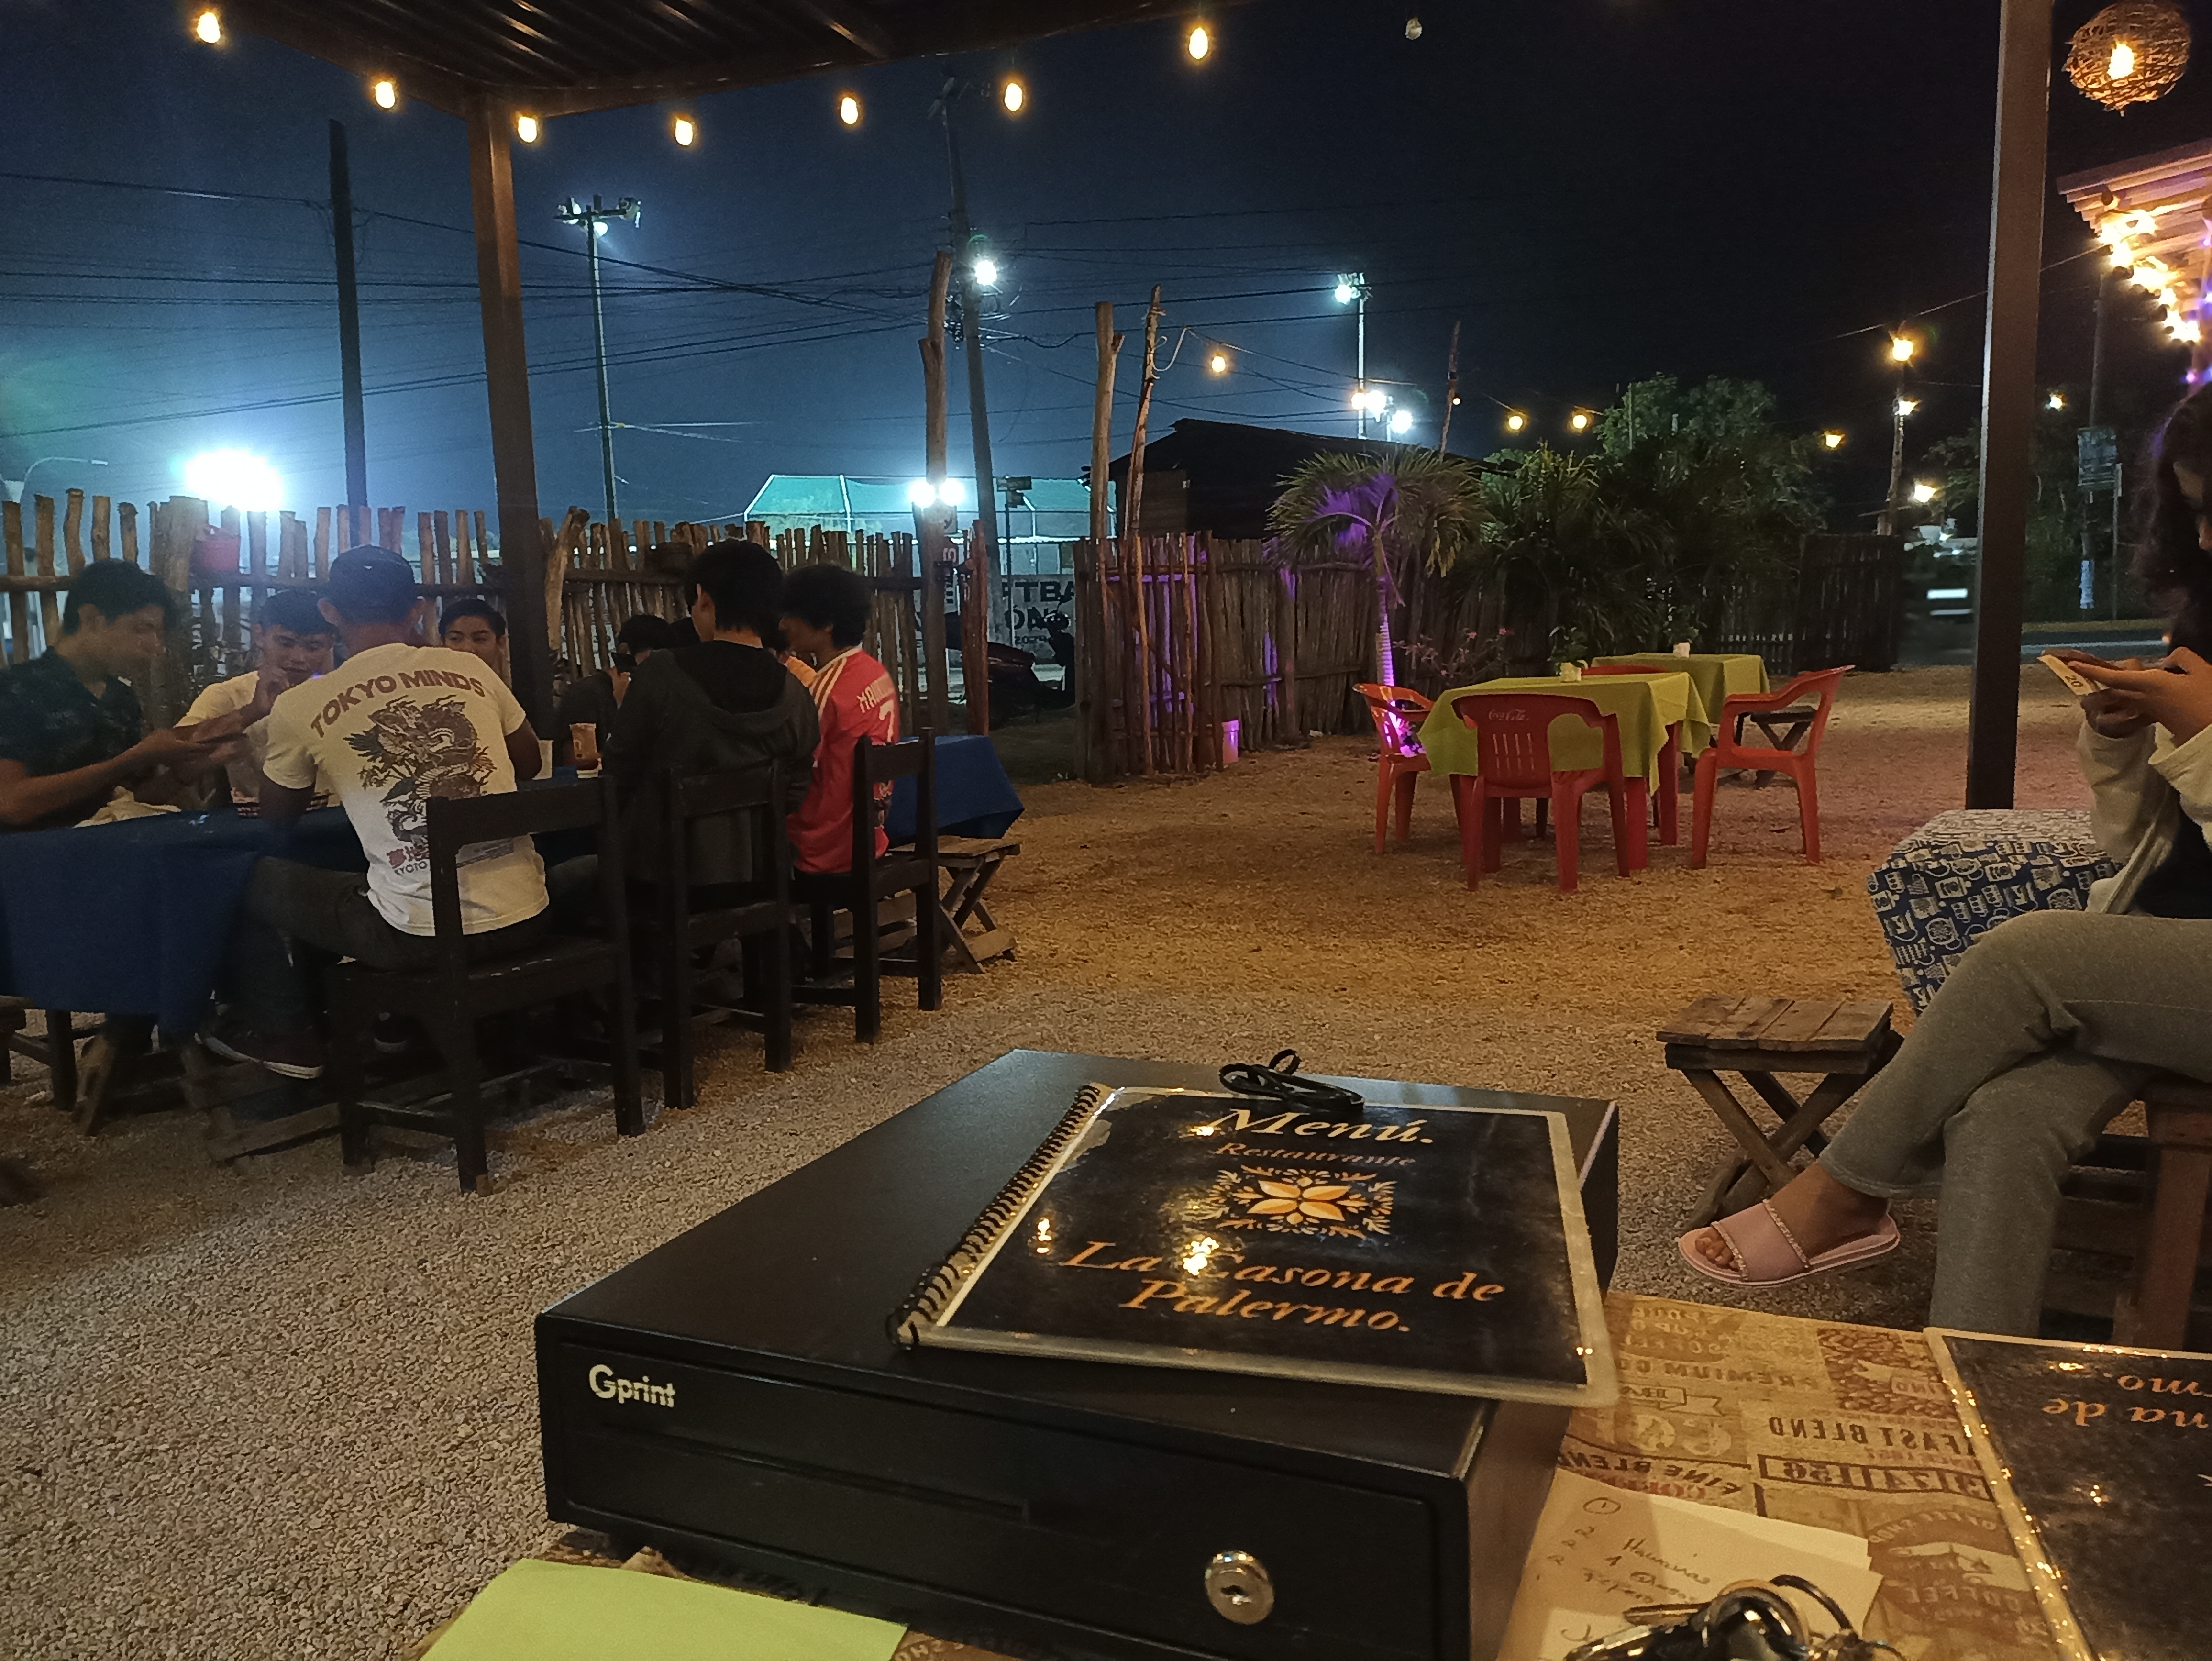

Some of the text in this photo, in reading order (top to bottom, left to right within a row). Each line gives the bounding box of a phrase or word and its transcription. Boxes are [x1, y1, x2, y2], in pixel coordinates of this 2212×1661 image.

[310, 670, 486, 738] TOKYO MINDS
[394, 861, 428, 876] KYOTO
[1058, 1240, 1162, 1272] La
[1432, 1271, 1505, 1301] de
[1117, 1278, 1410, 1332] Palermo.
[589, 1364, 676, 1408] Gprint
[2041, 1398, 2109, 1427] de
